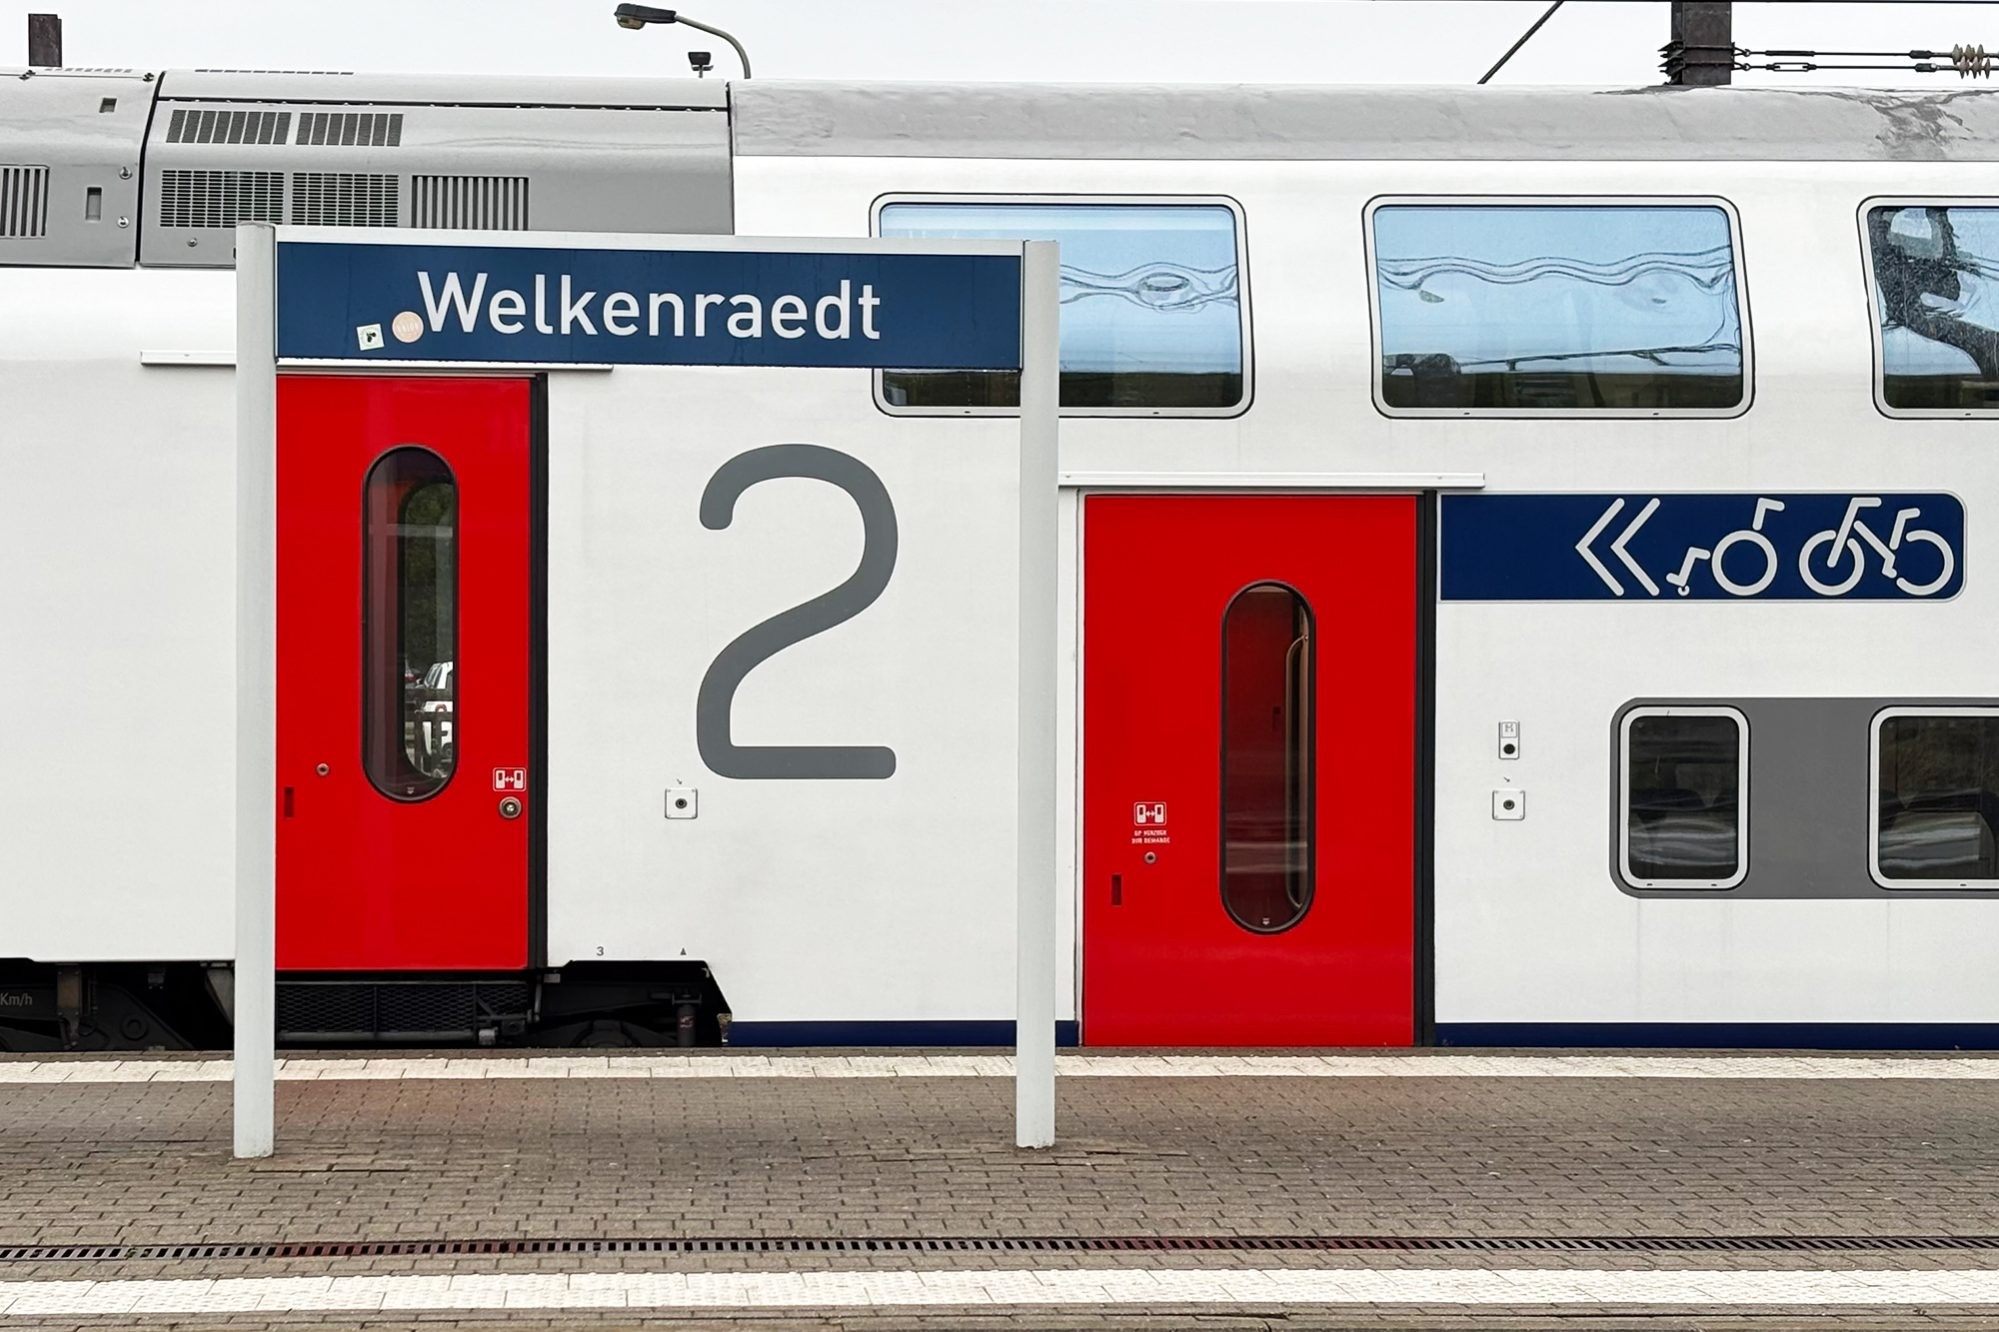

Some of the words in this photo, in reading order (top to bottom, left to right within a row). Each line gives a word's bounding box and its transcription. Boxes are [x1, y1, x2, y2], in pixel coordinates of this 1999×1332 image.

[417, 271, 881, 340] Welkenraedt
[696, 443, 899, 780] 2
[596, 946, 605, 957] 3
[0, 992, 33, 1006] Km/h
